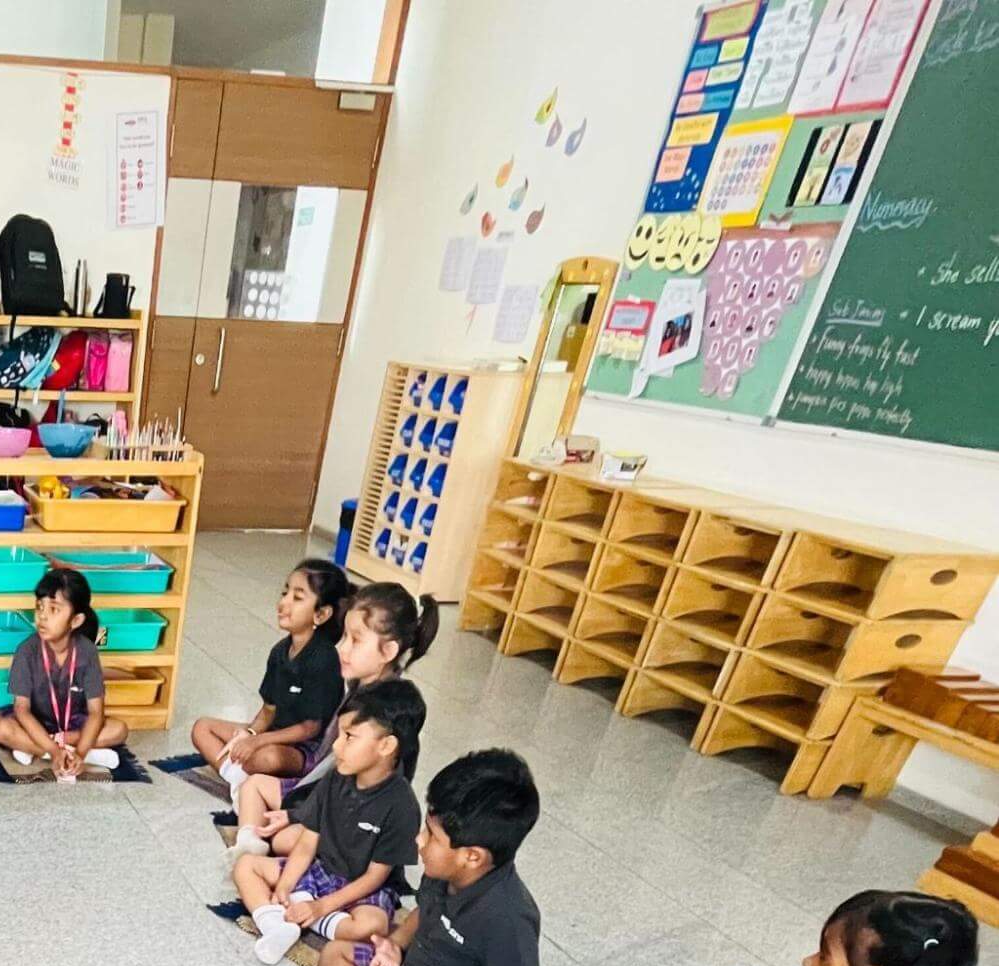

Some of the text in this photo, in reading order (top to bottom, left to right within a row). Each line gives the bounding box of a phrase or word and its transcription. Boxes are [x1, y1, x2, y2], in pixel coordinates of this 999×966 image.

[50, 156, 80, 172] MAGIC
[48, 172, 80, 188] WORDS
[930, 251, 960, 286] She
[927, 310, 982, 332] scream
